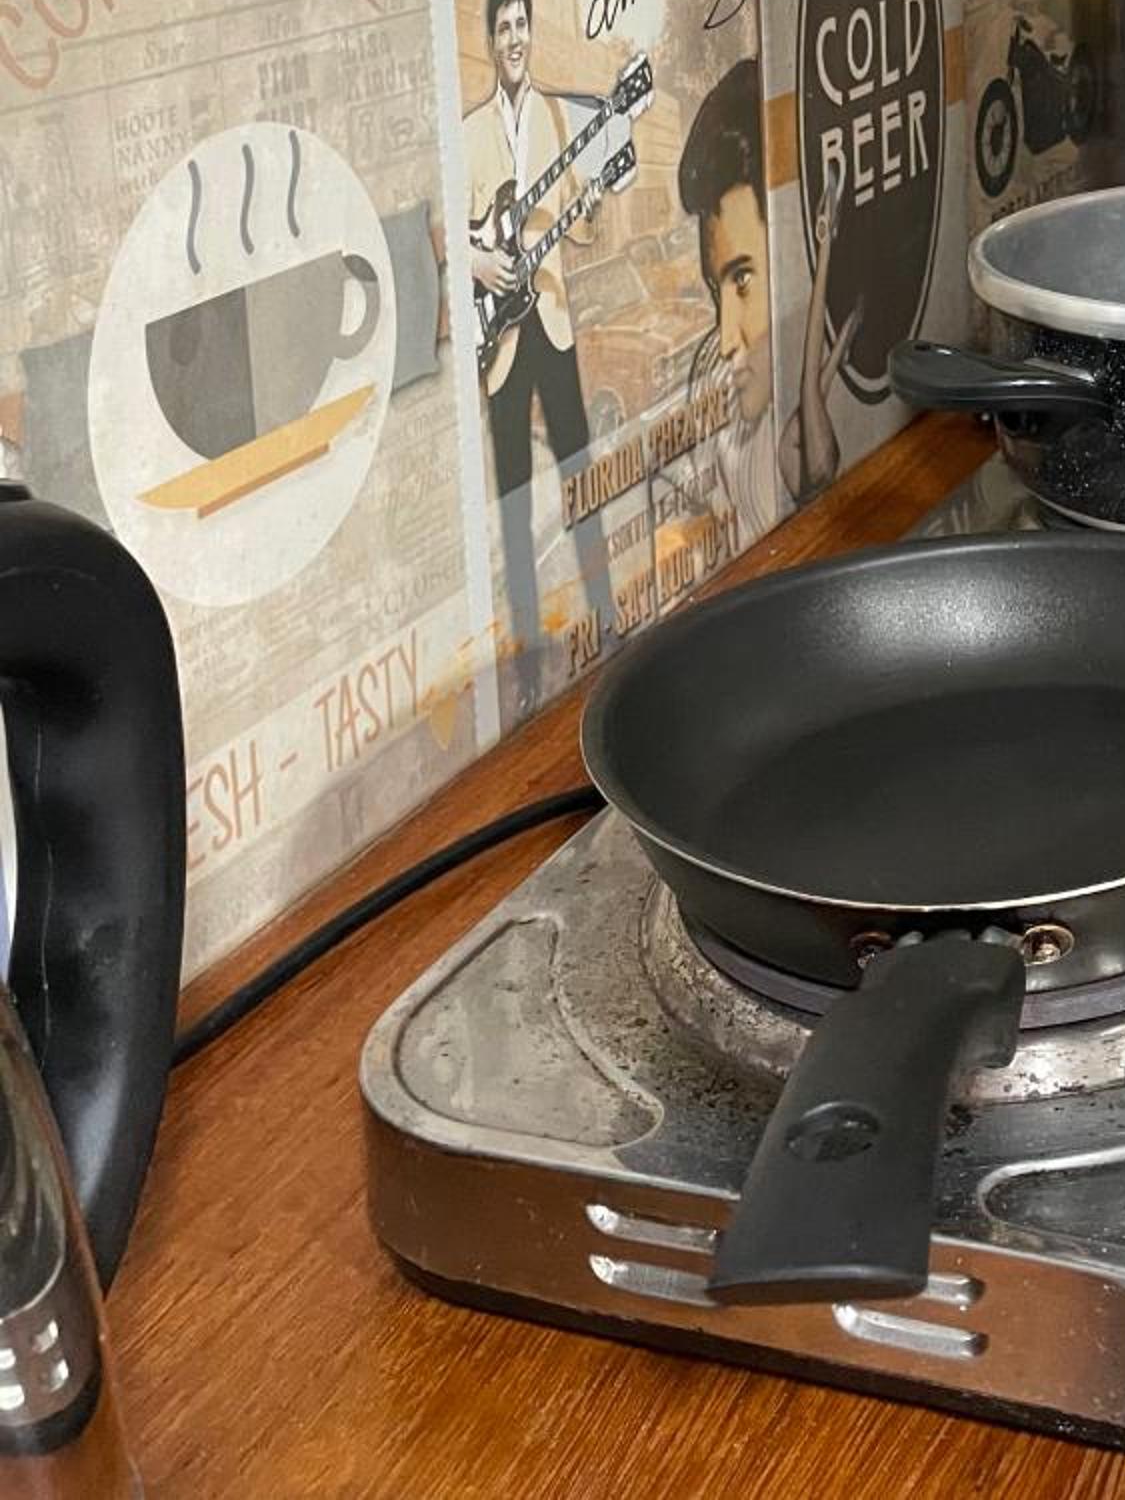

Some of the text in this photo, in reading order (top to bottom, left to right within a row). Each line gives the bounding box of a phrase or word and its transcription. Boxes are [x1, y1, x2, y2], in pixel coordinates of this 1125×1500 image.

[820, 91, 929, 206] BEER
[650, 386, 732, 474] THEATRE
[562, 435, 647, 532] FLORIDA
[314, 629, 420, 772] TASTY
